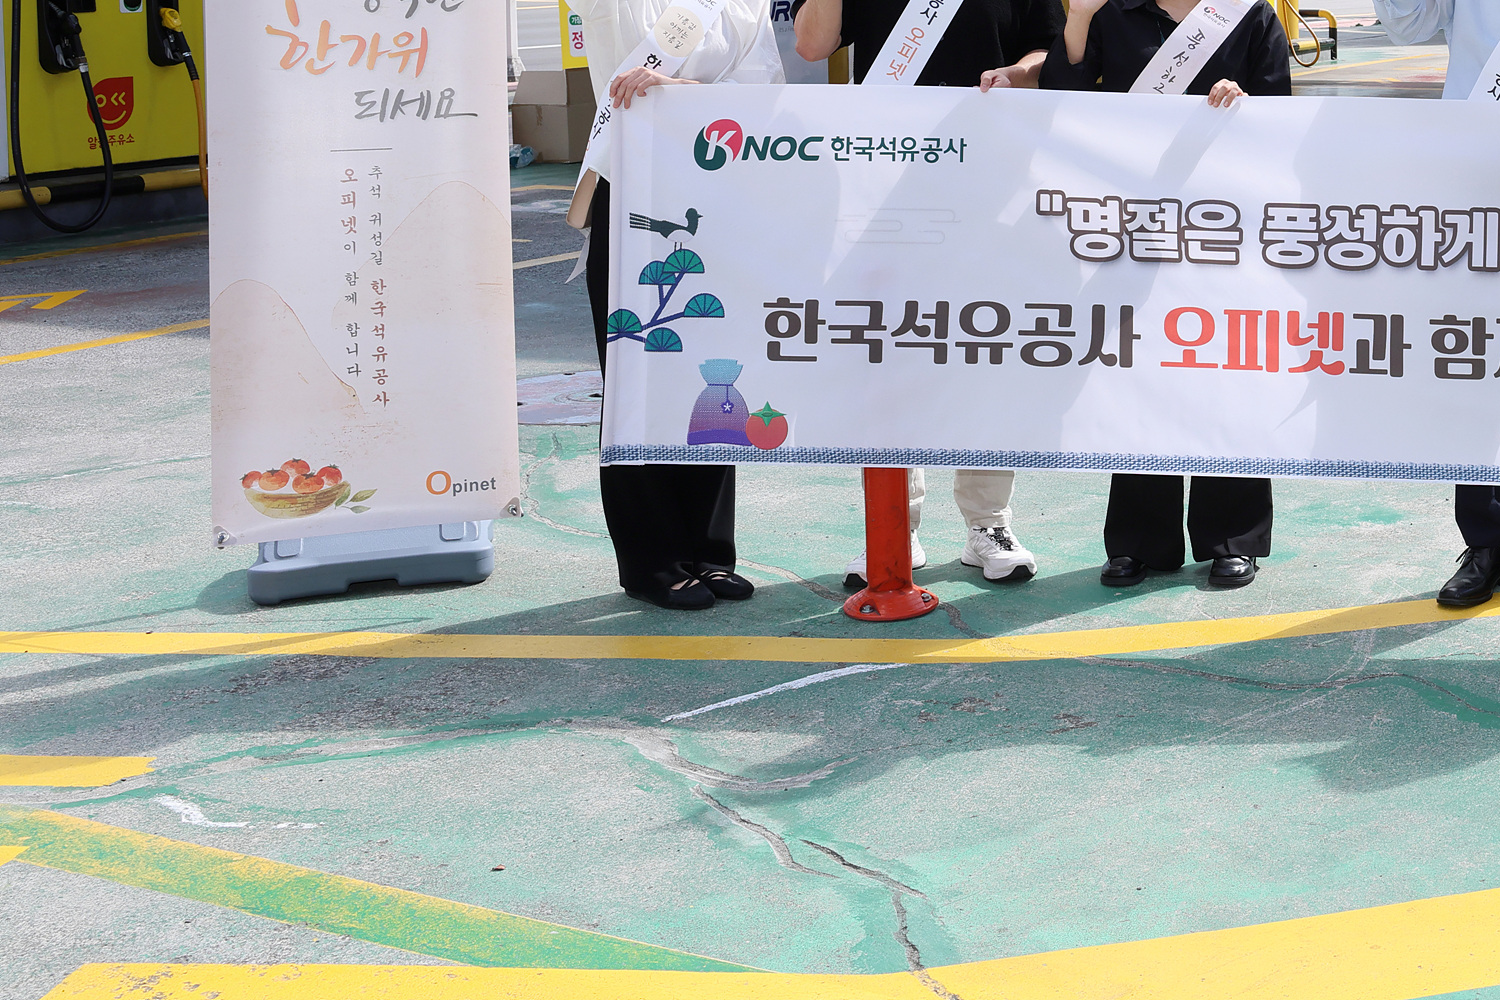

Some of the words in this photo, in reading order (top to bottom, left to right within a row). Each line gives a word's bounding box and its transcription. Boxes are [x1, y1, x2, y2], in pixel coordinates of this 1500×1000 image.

[663, 31, 684, 49] 지름길
[886, 27, 925, 81] 오피넷
[1153, 28, 1206, 94] 풍성하고
[354, 87, 478, 122] 되세요
[87, 133, 135, 150] 알주유소
[693, 118, 824, 171] KNOC
[831, 135, 968, 164] 한국석유공사
[368, 165, 383, 198] 추석
[340, 168, 358, 255] 오피넷이
[1036, 188, 1243, 266] "명절은
[369, 213, 383, 266] 귀성길
[344, 271, 359, 306] 함께
[370, 279, 390, 408] 한국석유공사
[763, 297, 1141, 368] 한국석유공사
[1159, 305, 1412, 378] 오피넷과
[425, 470, 496, 497] Opinet
